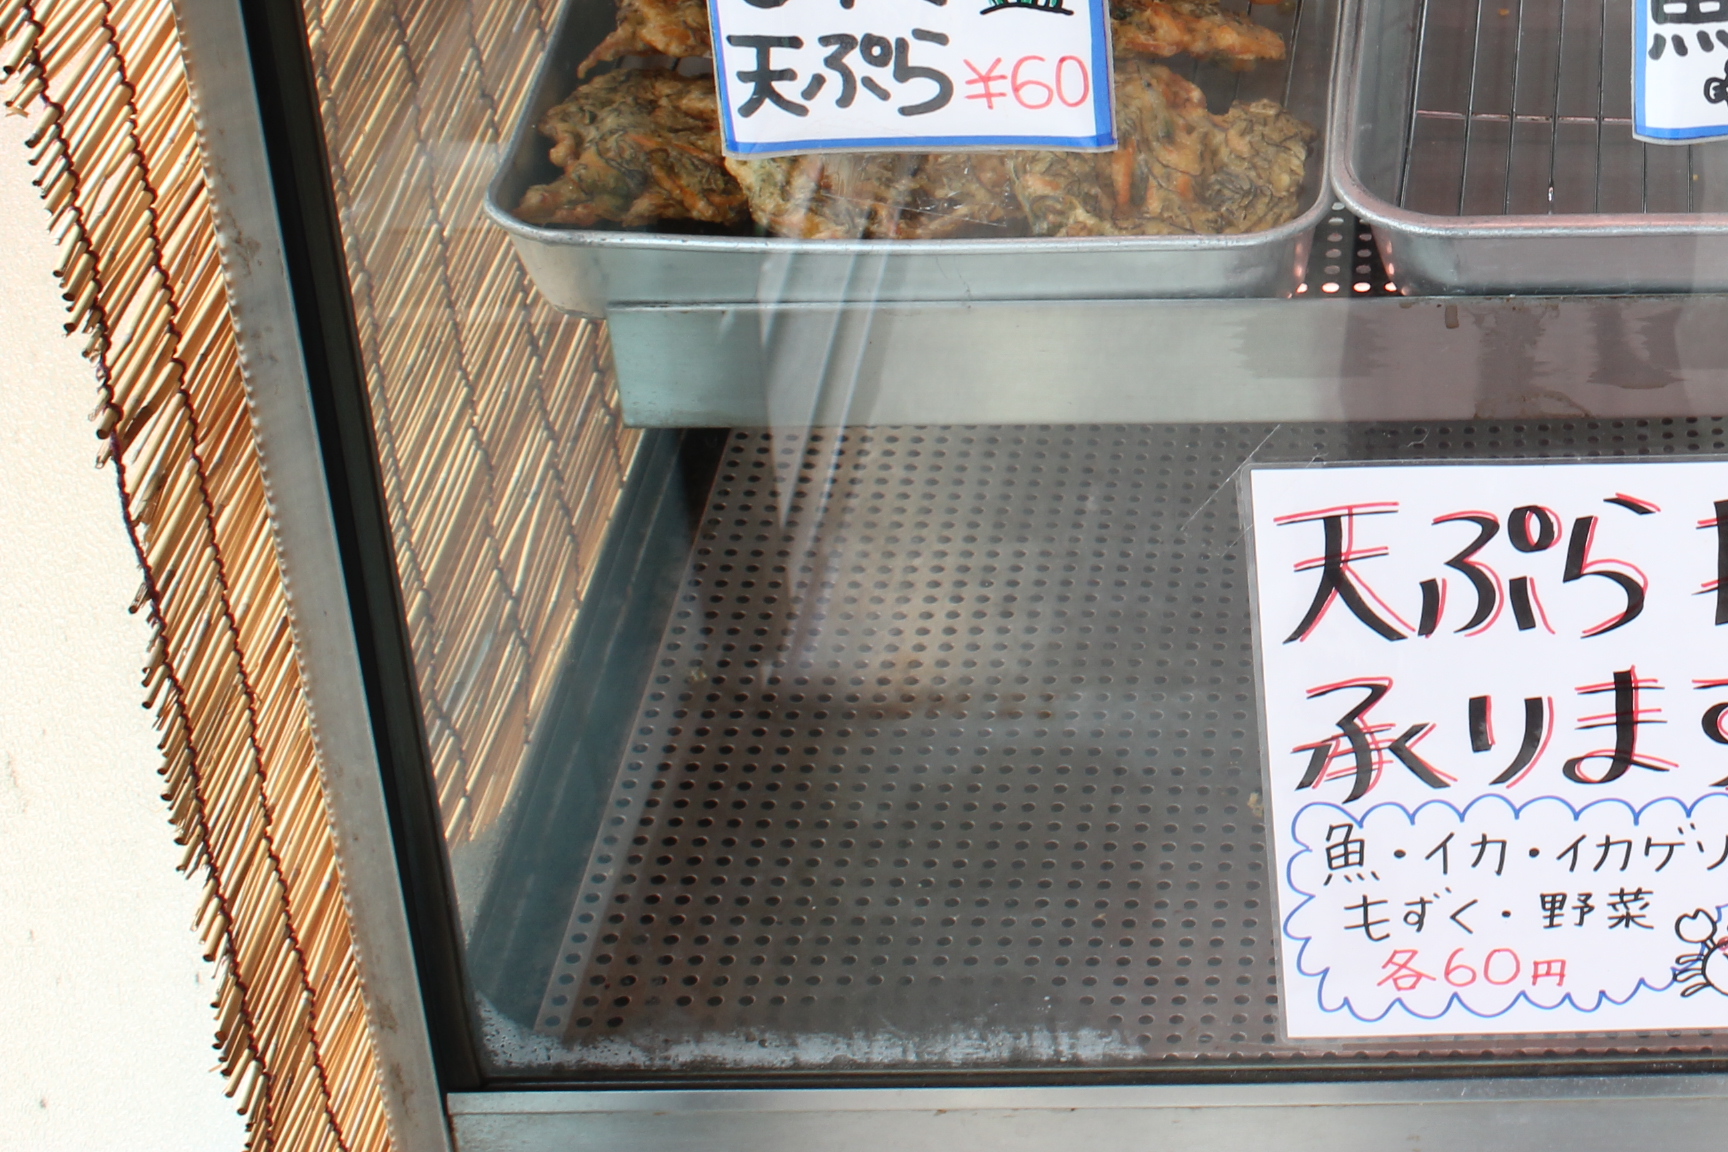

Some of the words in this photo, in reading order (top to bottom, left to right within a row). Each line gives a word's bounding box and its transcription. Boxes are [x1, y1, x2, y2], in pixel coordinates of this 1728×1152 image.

[726, 28, 954, 118] 天ぷら
[963, 54, 1090, 110] ¥60
[1344, 887, 1654, 942] もずく・野菜
[1377, 946, 1567, 992] 各60円
